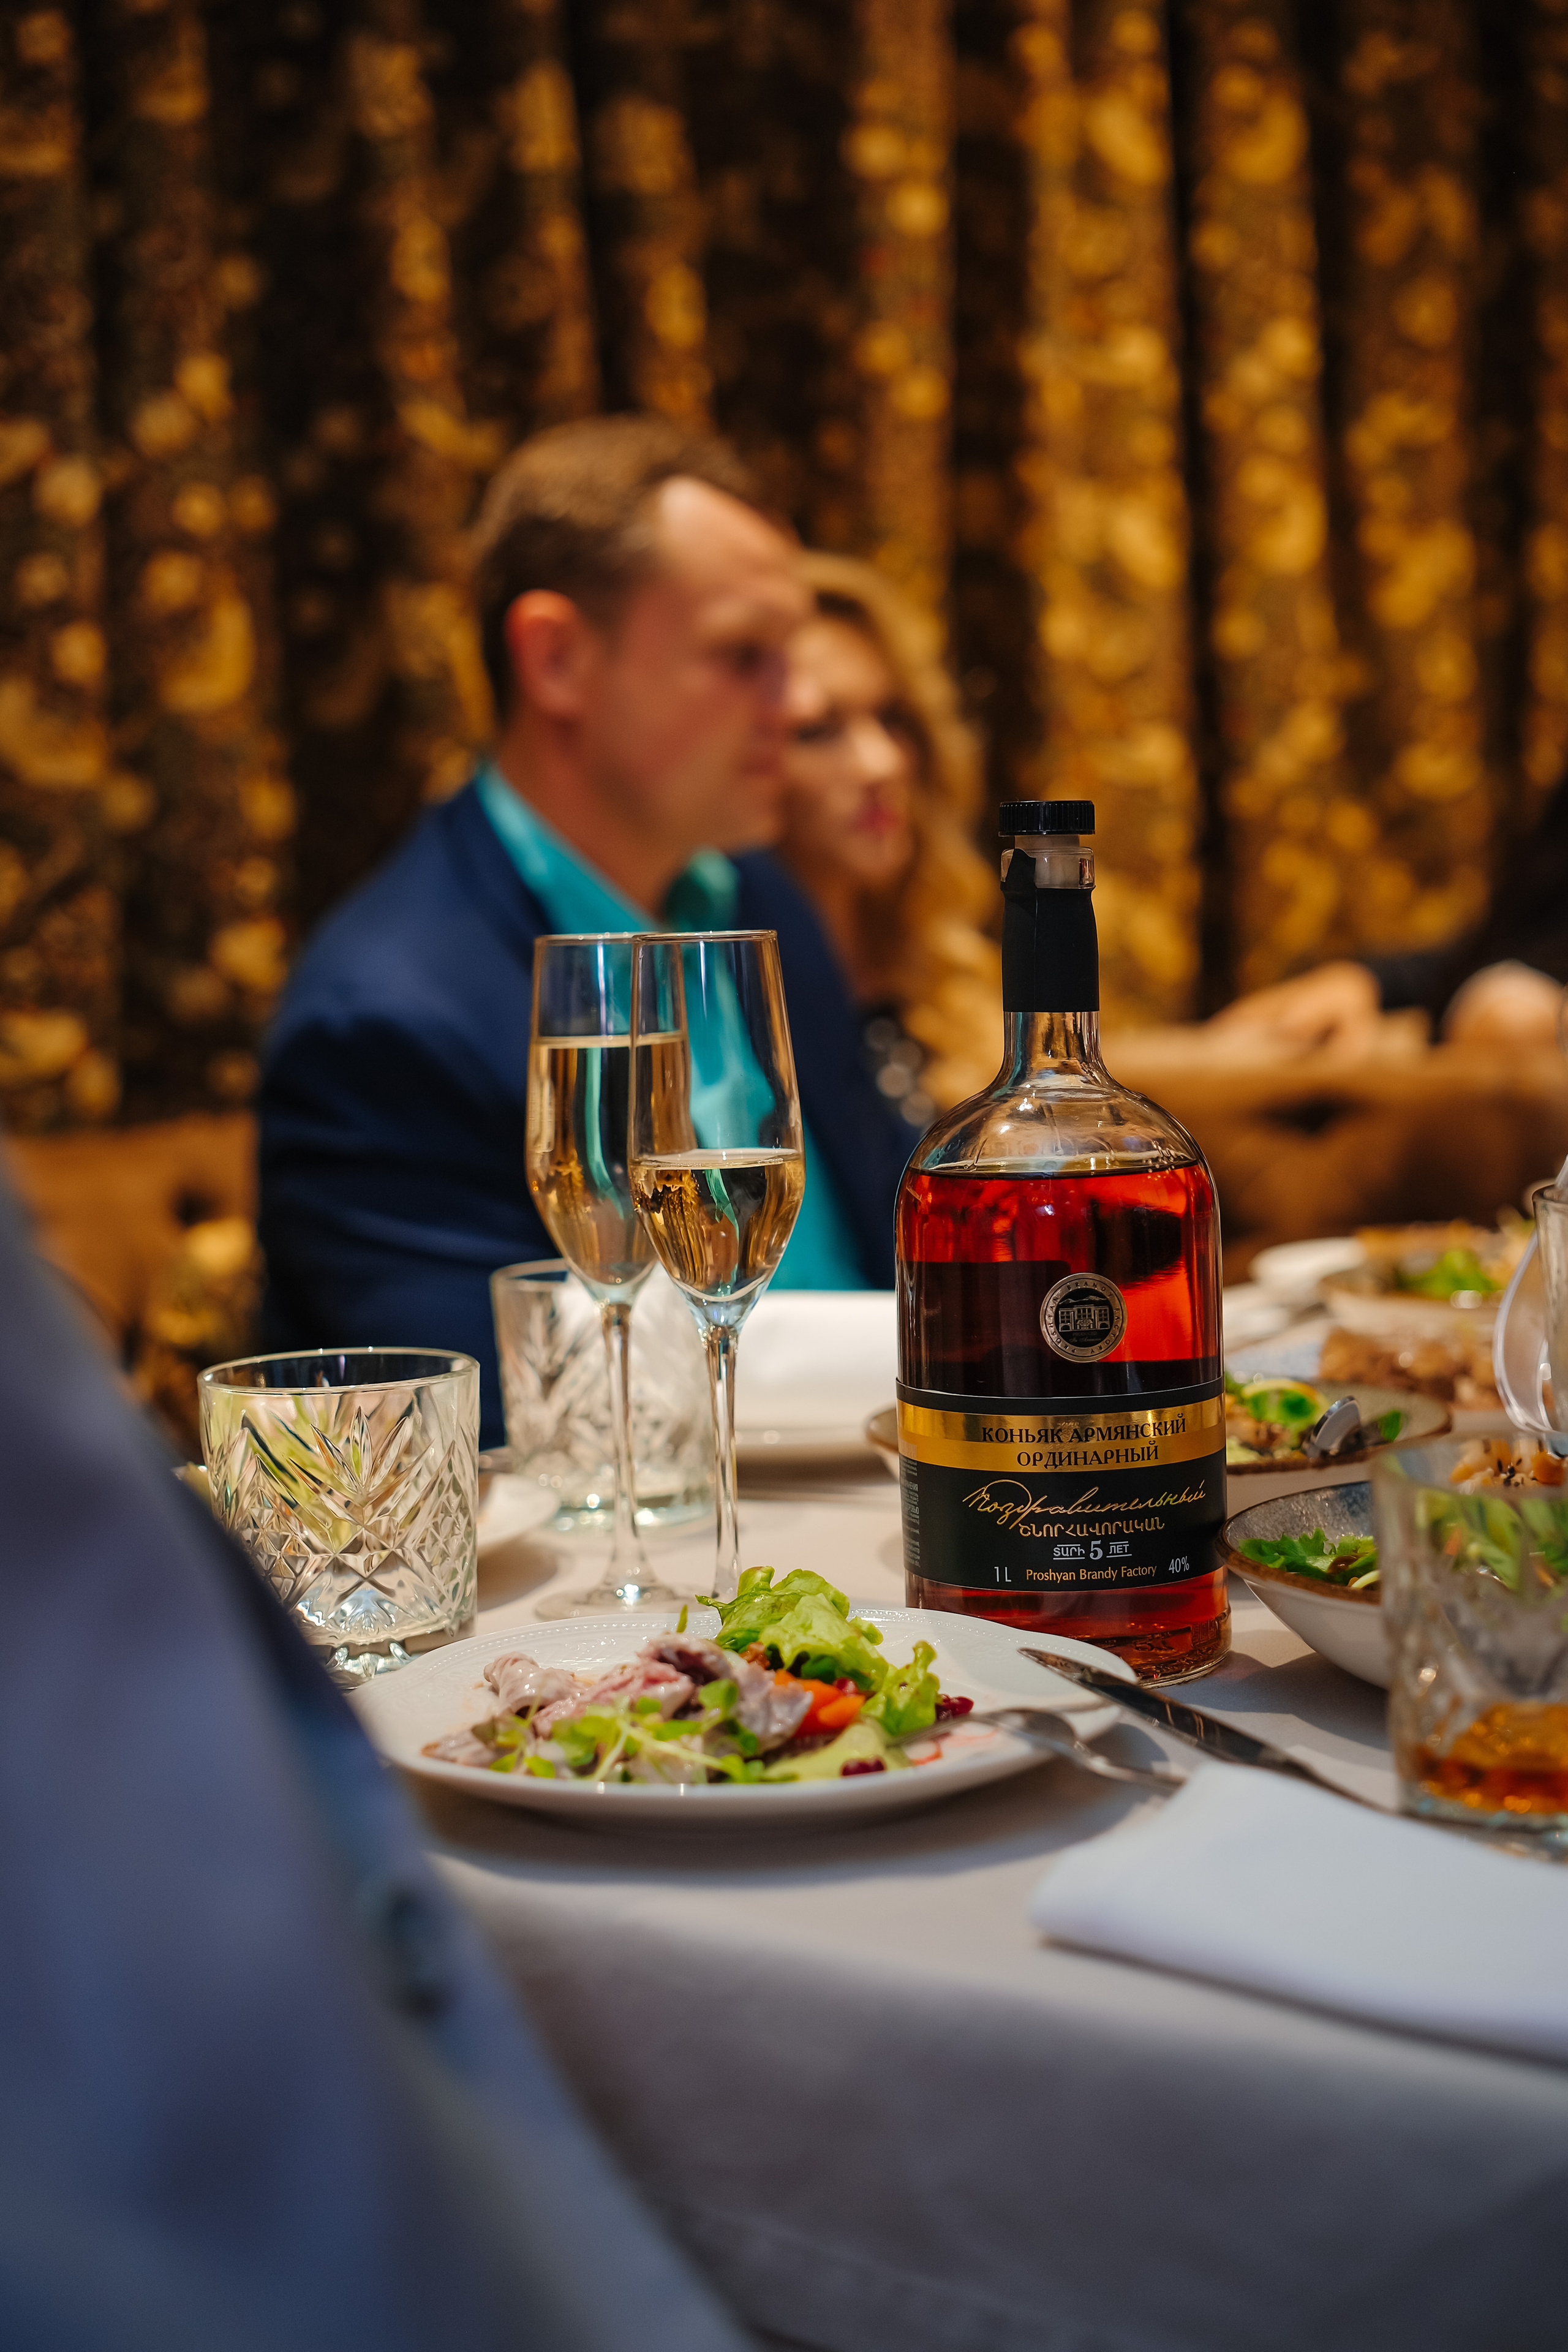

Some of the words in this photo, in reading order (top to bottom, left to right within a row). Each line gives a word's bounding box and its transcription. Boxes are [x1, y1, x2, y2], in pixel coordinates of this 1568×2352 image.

[1047, 1296, 1076, 1353] PROSHYAN
[1067, 1281, 1113, 1297] BRANDY
[982, 1427, 1063, 1443] КОНЬЯК
[1069, 1412, 1186, 1442] АРМЯНСКИЙ
[1017, 1440, 1159, 1469] ОРДИНАРНЫЙ
[962, 1479, 1206, 1529] Поздравительный
[1089, 1539, 1103, 1560] 5
[1109, 1544, 1129, 1554] ЛЕТ
[1026, 1569, 1076, 1583] Proshyan
[1079, 1566, 1118, 1581] Brandy
[1121, 1565, 1157, 1577] Factory
[1168, 1556, 1189, 1574] 40%
